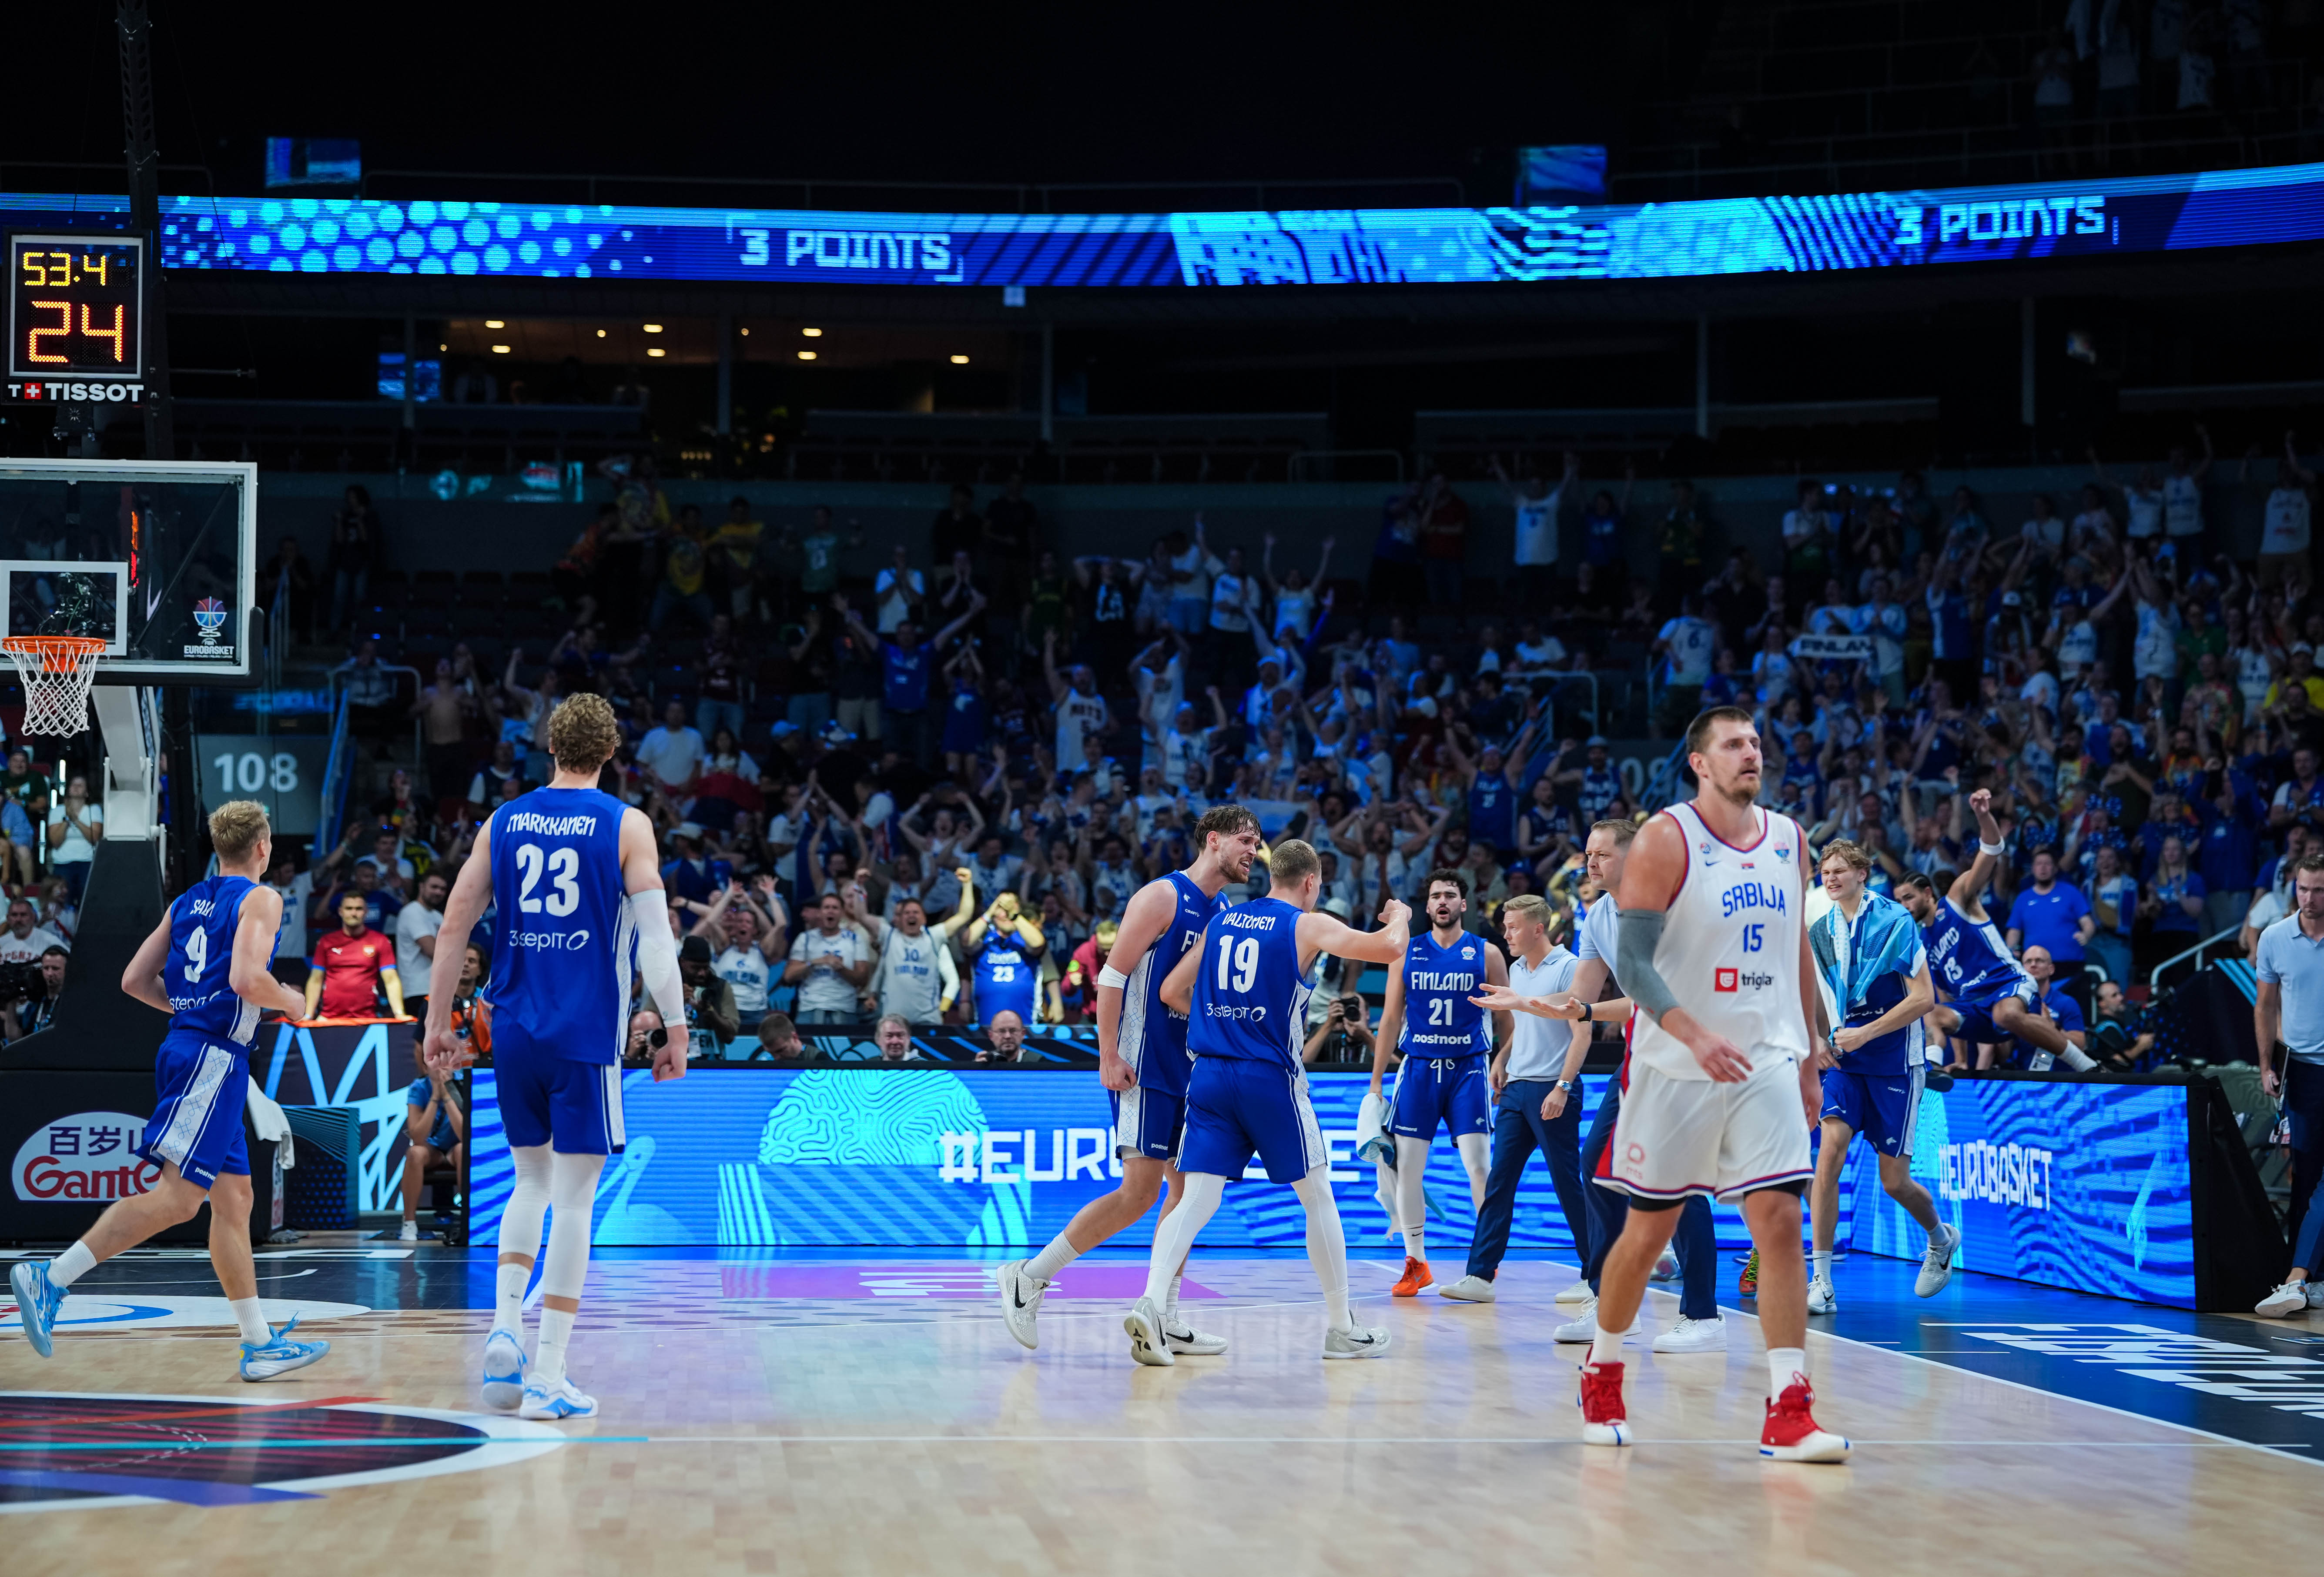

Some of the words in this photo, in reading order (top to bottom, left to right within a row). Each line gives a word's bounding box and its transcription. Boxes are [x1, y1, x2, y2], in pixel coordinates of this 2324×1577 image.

[1893, 206, 1922, 244] 3
[1940, 196, 2105, 242] POINTS
[740, 229, 769, 265] 3
[786, 230, 951, 269] POINTS
[23, 252, 107, 286] 53.4
[29, 301, 123, 362] 24
[45, 383, 144, 401] TISSOT
[184, 645, 234, 655] EUROBASKET
[214, 752, 298, 793] 108
[506, 812, 596, 837] MARKKANEN
[516, 843, 579, 917] 23
[1722, 883, 1785, 917] SRBIJA
[1222, 912, 1276, 931] VALTONEN
[1743, 924, 1764, 952] 15
[184, 925, 208, 983] 9
[1219, 935, 1259, 993] 19
[992, 965, 1015, 982] 23
[1411, 972, 1474, 991] FINLAND
[1742, 972, 1774, 990] trigla
[1429, 998, 1453, 1026] 21
[1412, 1034, 1471, 1045] postnord
[24, 1156, 165, 1199] Gante
[1939, 1139, 2053, 1212] #EUROBASKET
